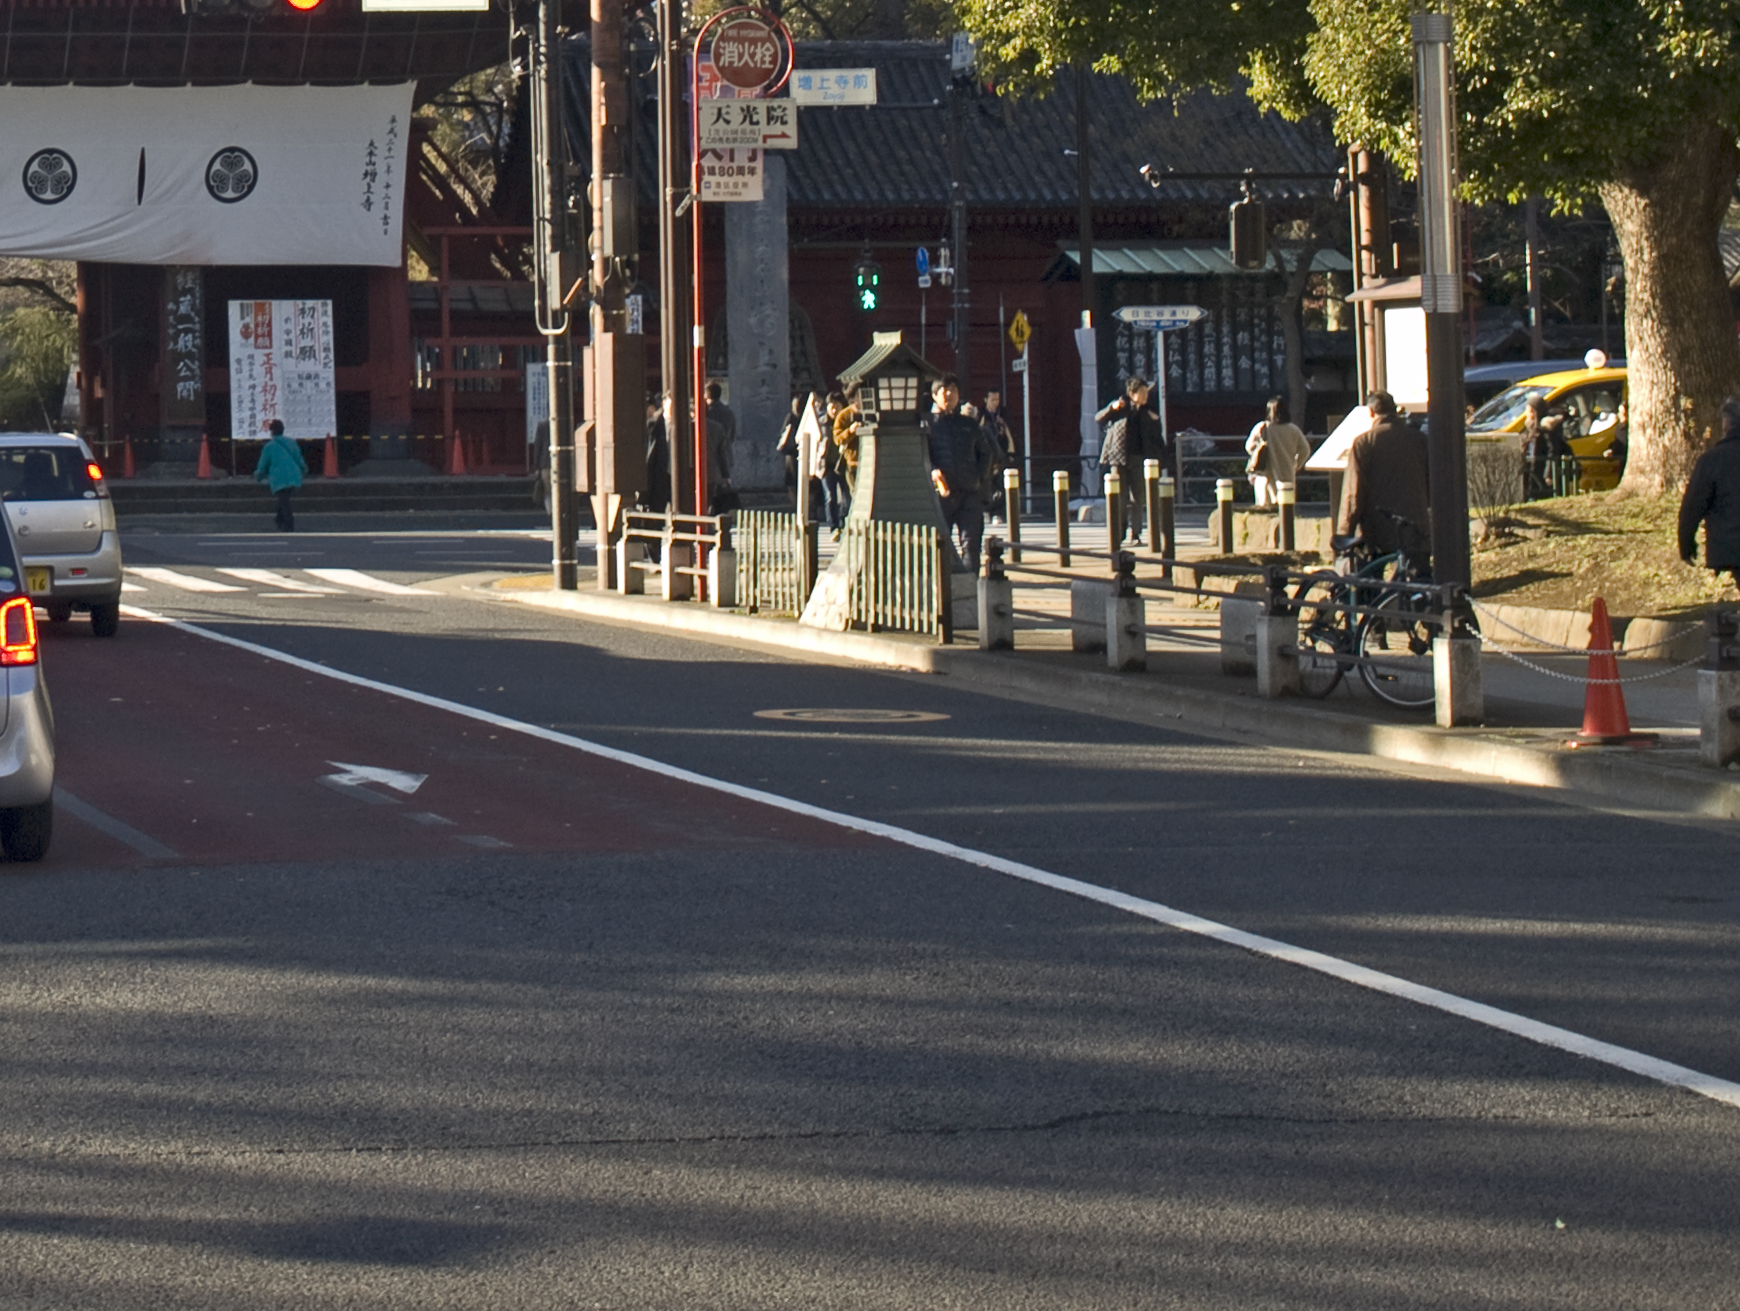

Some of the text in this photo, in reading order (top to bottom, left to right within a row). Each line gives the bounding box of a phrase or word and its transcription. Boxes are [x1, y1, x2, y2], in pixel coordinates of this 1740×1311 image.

[719, 41, 775, 69] 消火栓
[797, 74, 868, 90] 増上寺前
[711, 104, 789, 127] 天光院
